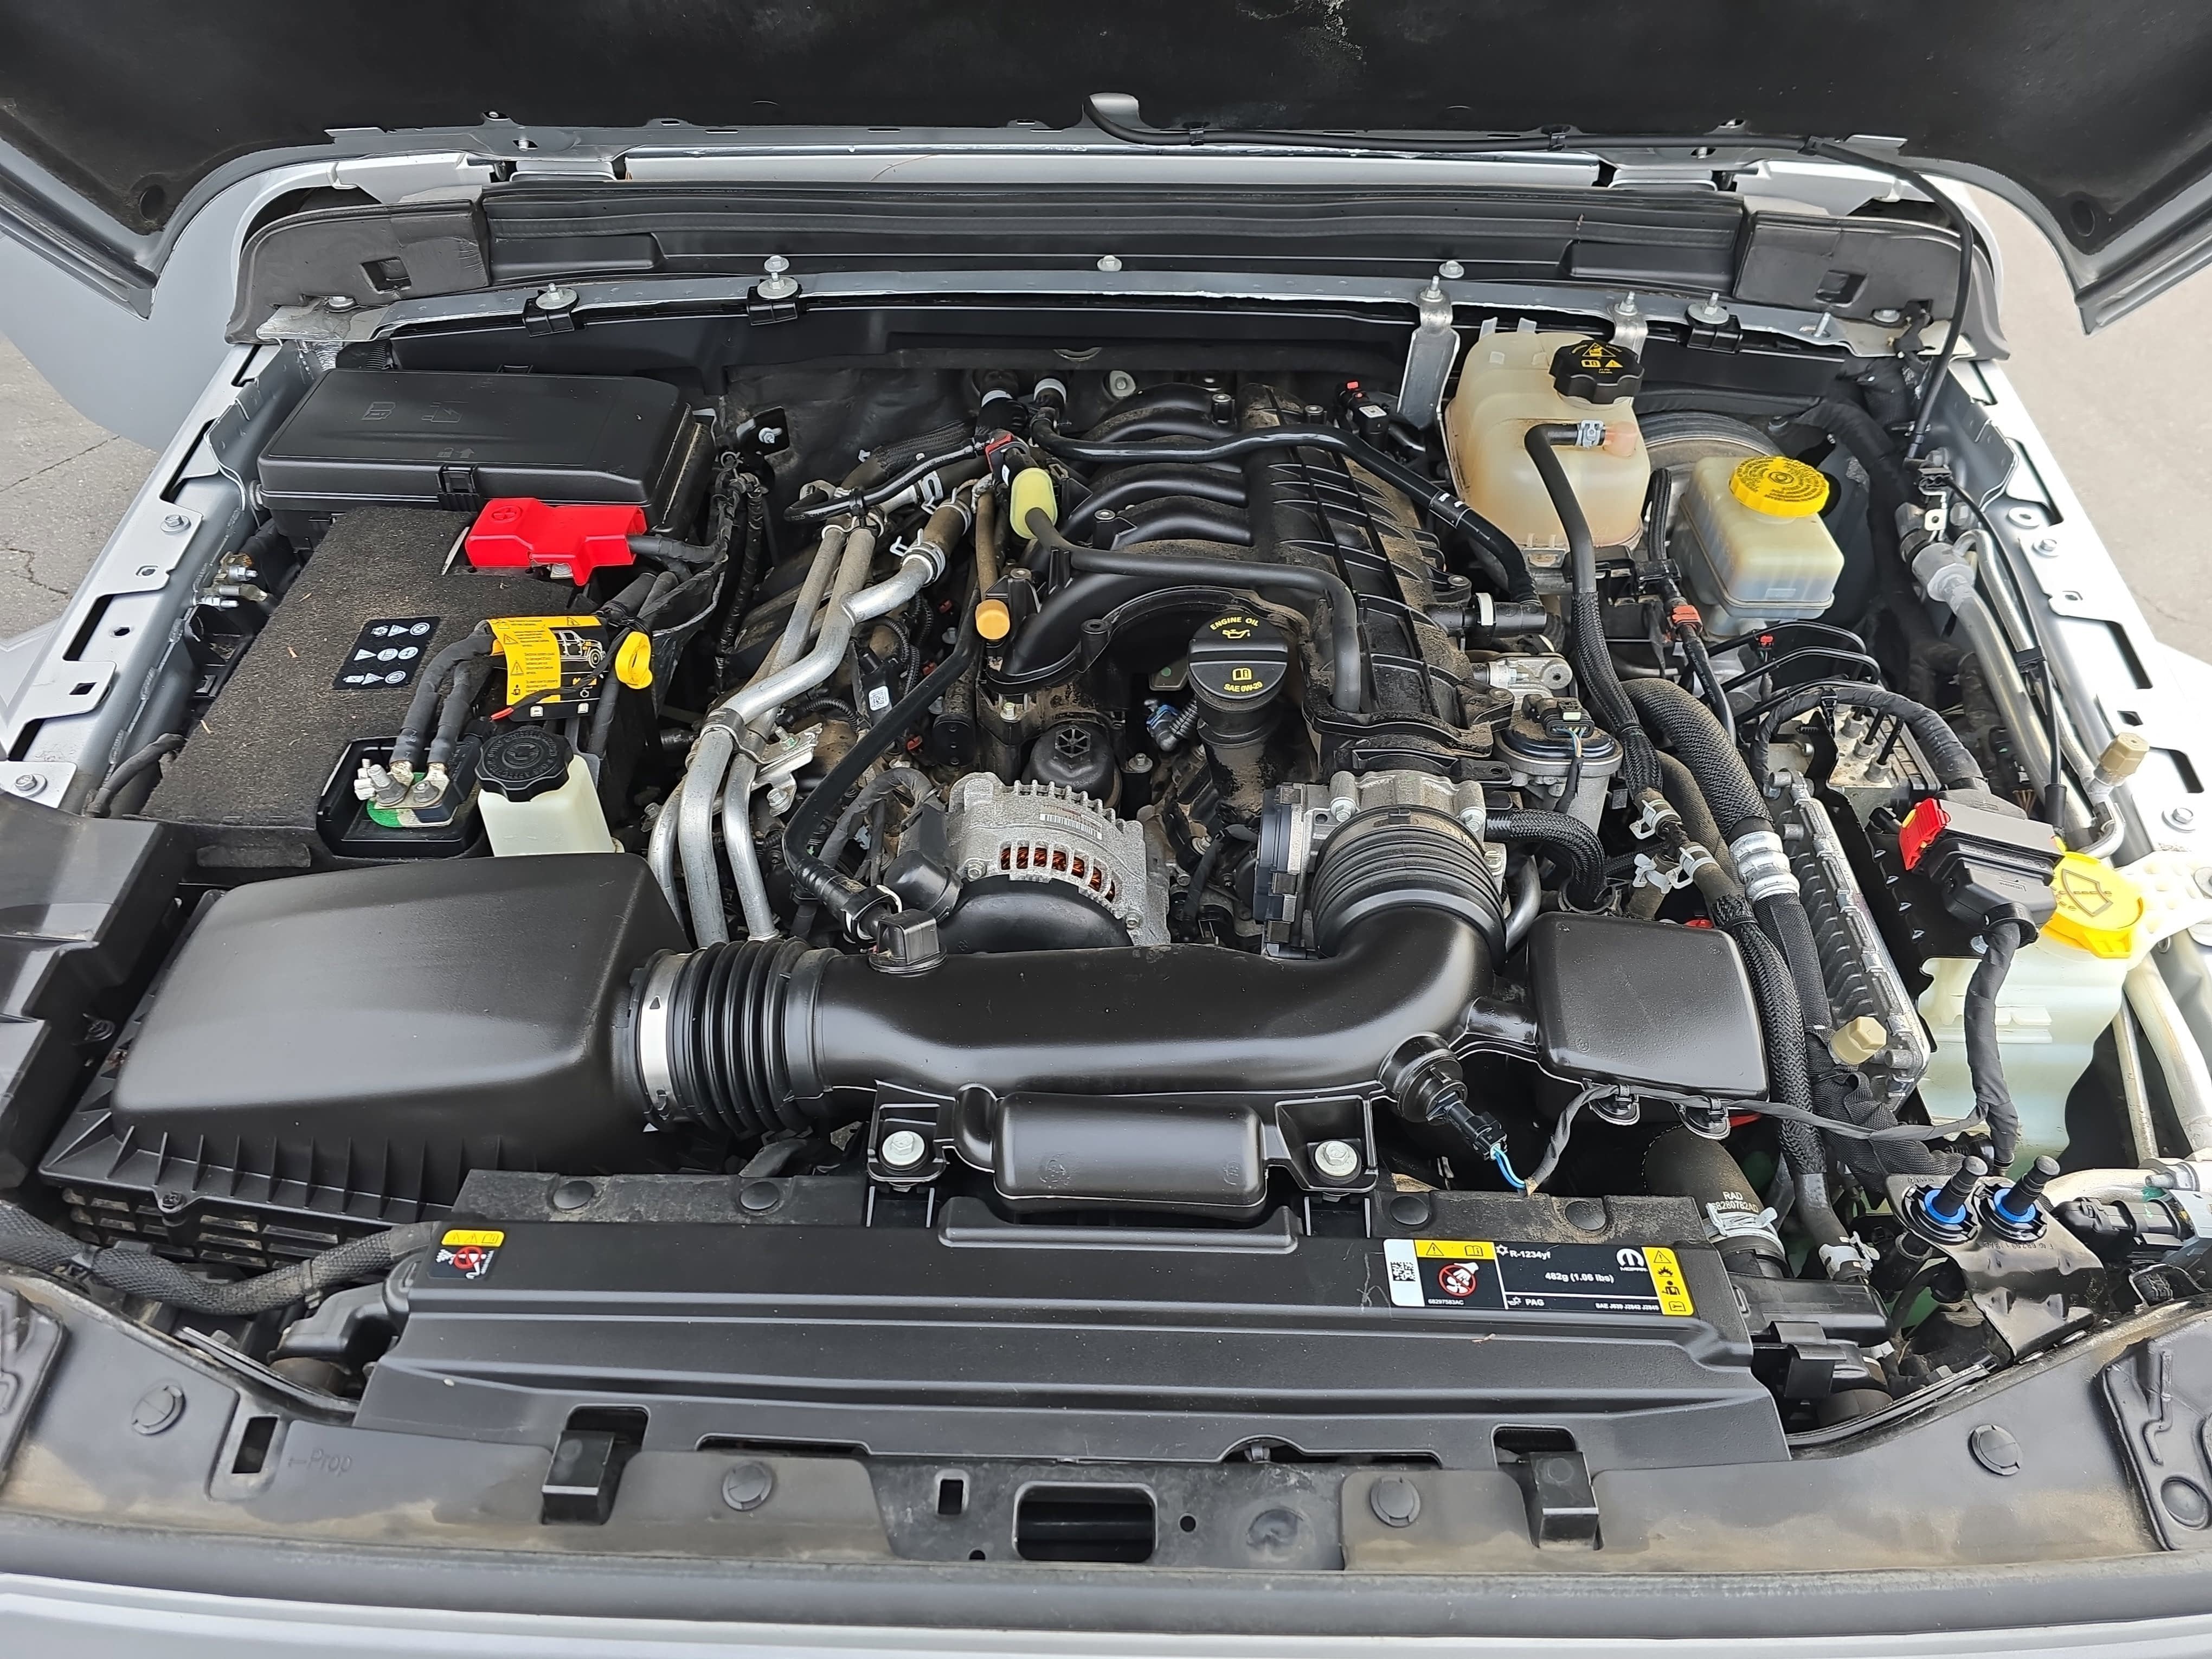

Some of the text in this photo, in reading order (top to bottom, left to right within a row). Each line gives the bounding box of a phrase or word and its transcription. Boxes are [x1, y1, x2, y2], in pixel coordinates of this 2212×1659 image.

[1210, 616, 1259, 631] ENGINE OIL
[1224, 681, 1263, 692] SAE 0W-20
[1722, 1191, 1743, 1200] RAD
[1509, 1250, 1551, 1260] R-1234yf
[1545, 1272, 1614, 1284] 482g (1.06 lbs)
[307, 1448, 352, 1477] Prop
